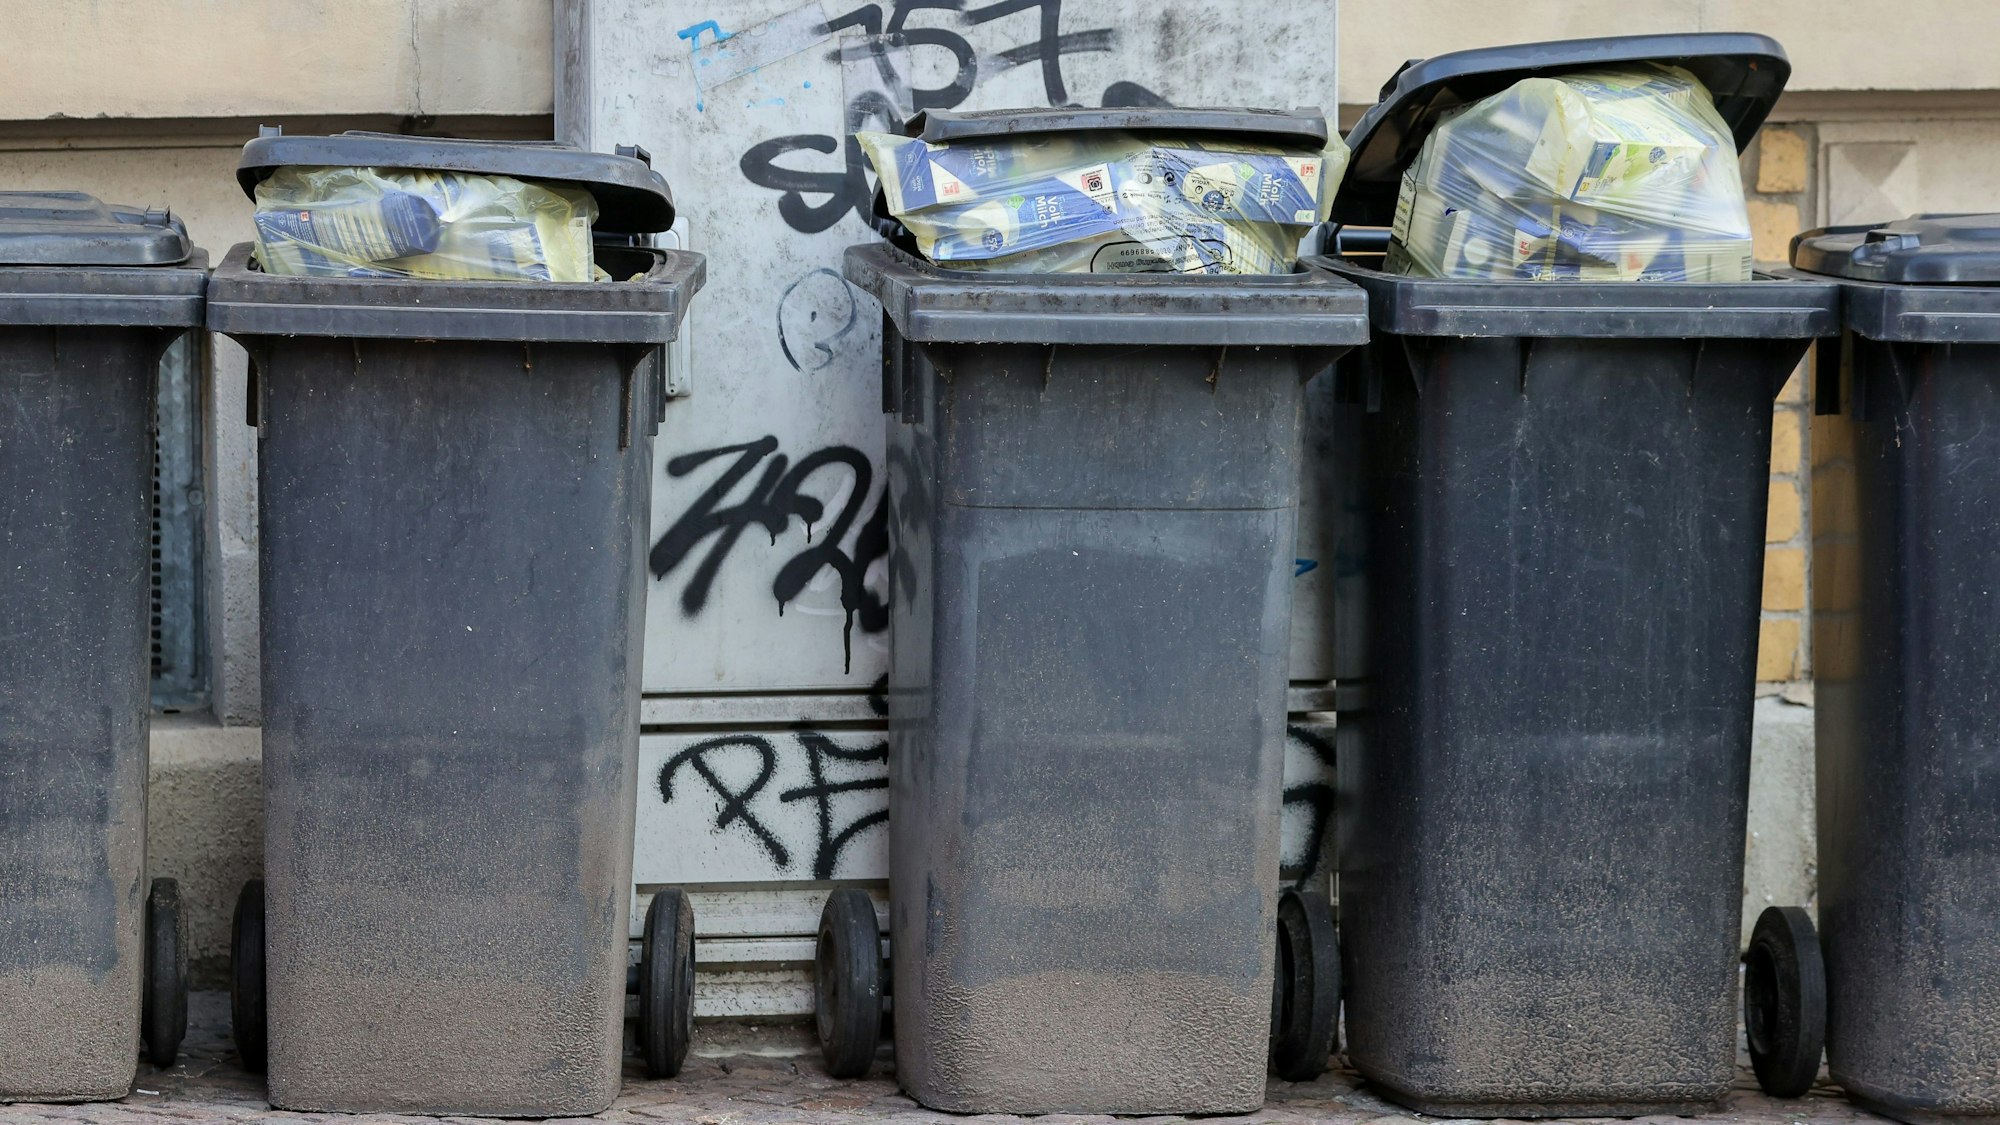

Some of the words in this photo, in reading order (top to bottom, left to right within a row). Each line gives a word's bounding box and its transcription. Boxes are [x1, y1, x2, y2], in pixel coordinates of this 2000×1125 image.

[1259, 173, 1273, 206] Milch
[1270, 178, 1282, 206] Voll-
[1034, 195, 1049, 228] Milch
[1047, 195, 1061, 224] Voll-
